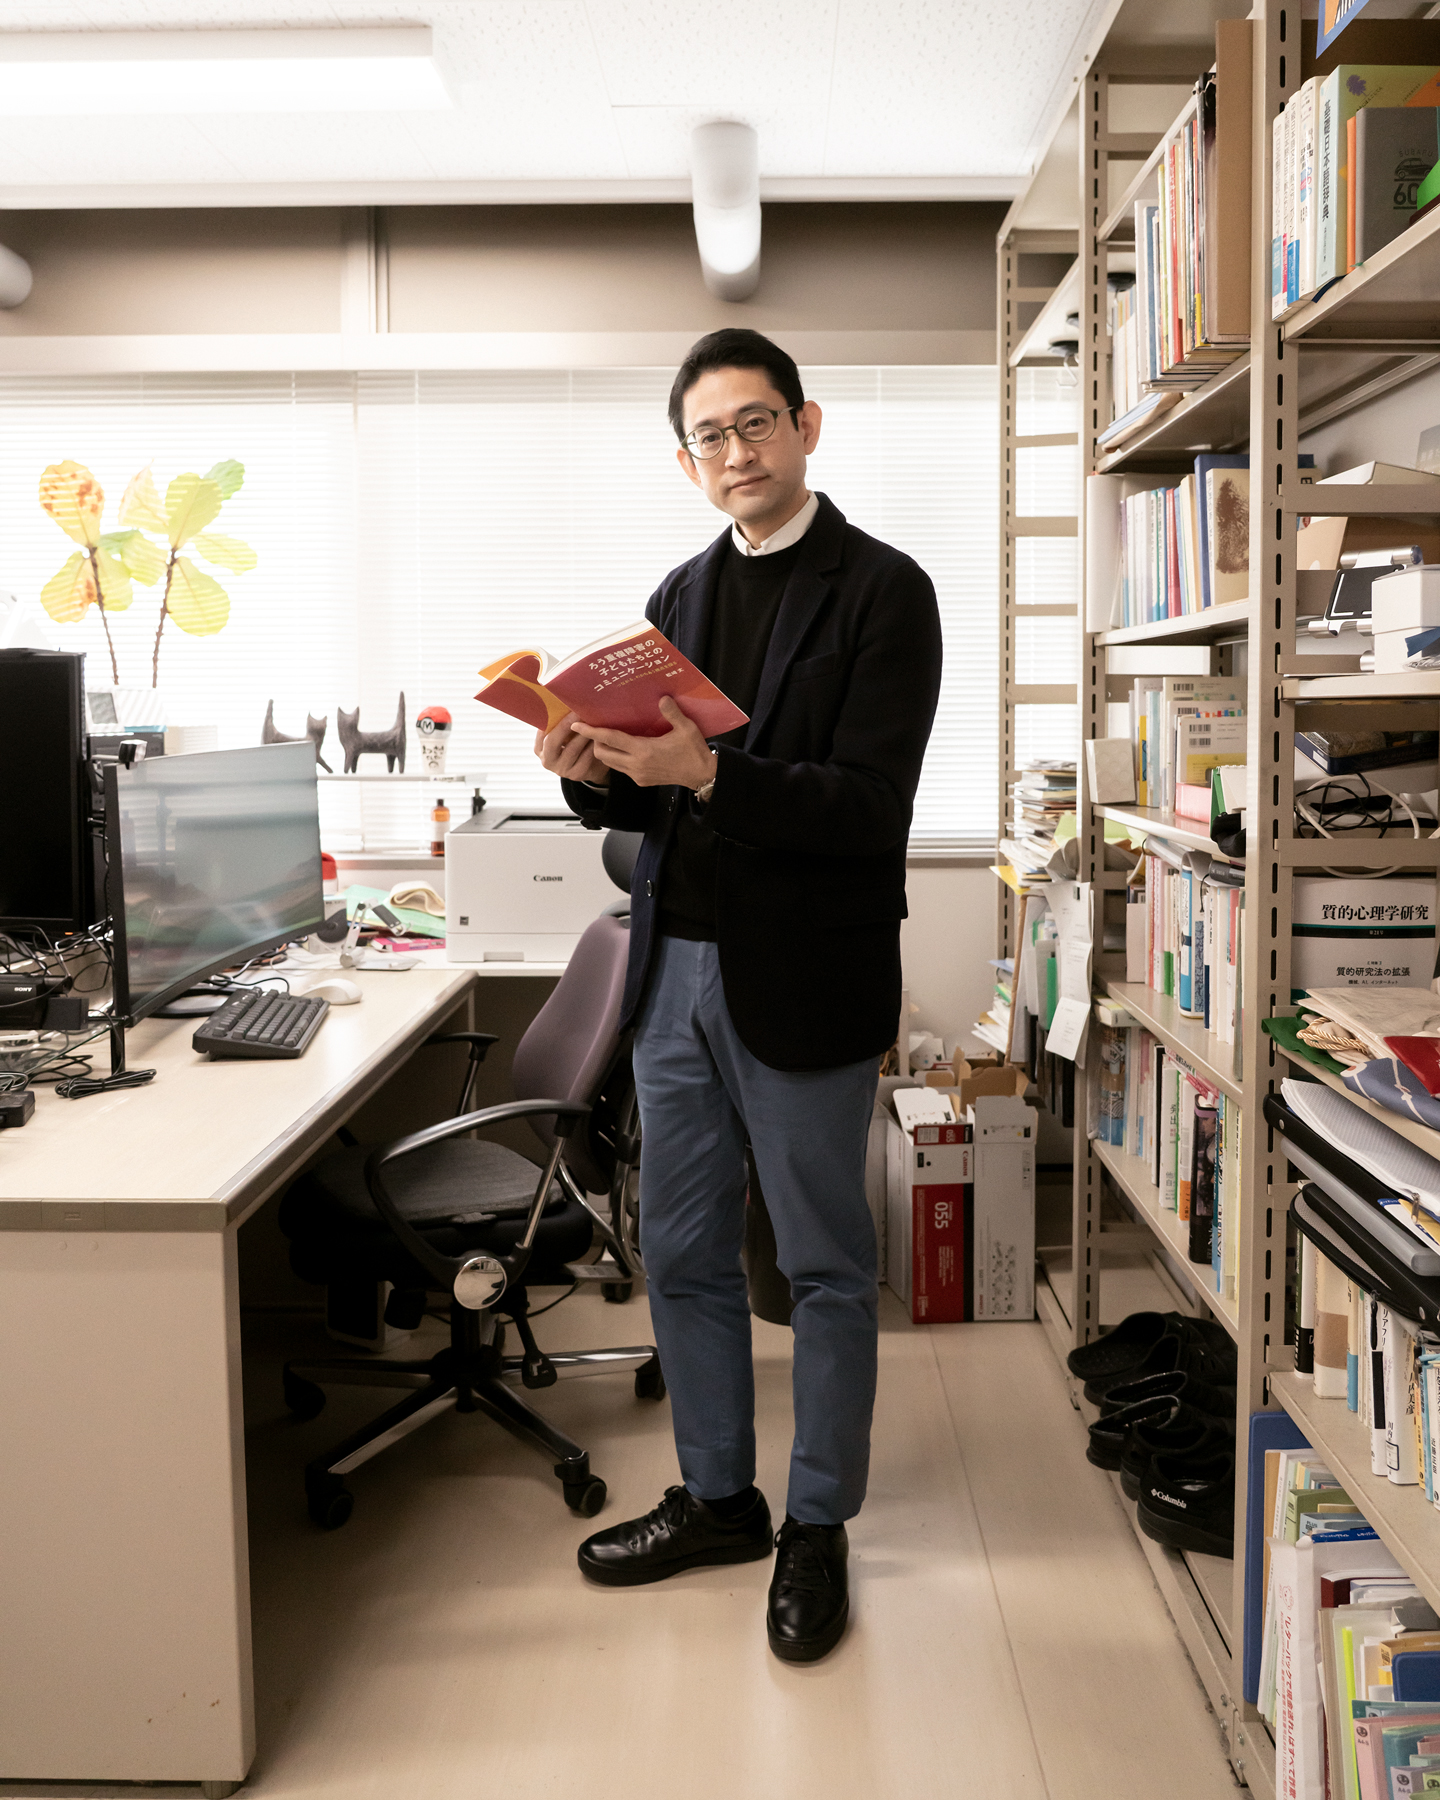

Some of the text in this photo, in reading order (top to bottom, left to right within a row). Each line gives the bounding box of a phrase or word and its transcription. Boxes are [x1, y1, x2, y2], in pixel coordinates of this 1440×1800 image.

[1399, 149, 1433, 158] SUBARU
[1393, 183, 1418, 206] 60
[588, 639, 655, 670] ろう重複障害の
[599, 647, 663, 677] 子どもたちとの
[594, 654, 670, 692] コミュニケーション
[423, 720, 432, 730] M
[533, 875, 564, 883] Canon
[1321, 904, 1429, 921] 質的心理学研究
[1336, 967, 1410, 977] 質的研究法の拡張
[934, 1201, 949, 1229] 055
[1156, 1491, 1187, 1509] Columbia
